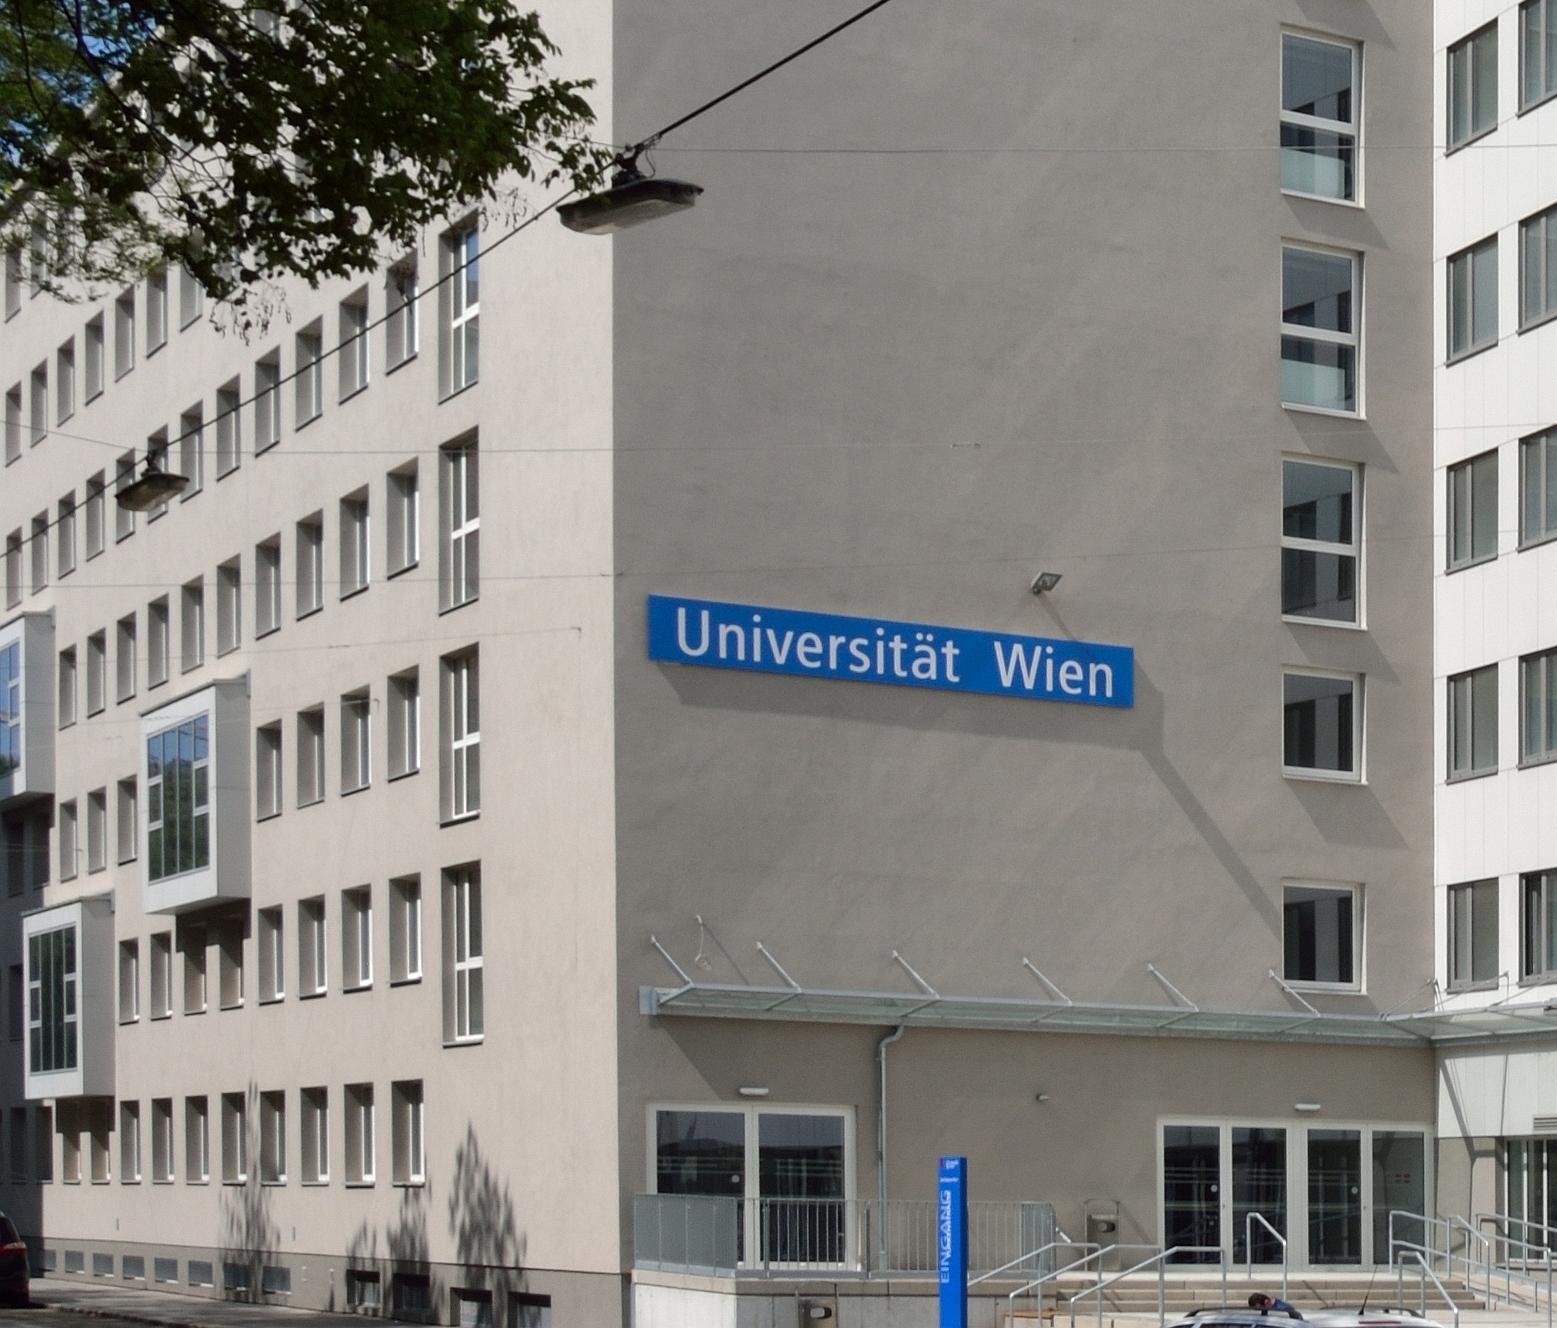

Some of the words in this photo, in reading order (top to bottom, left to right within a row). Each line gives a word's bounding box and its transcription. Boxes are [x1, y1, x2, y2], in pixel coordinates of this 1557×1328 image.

[675, 606, 961, 684] Universität
[993, 640, 1114, 698] Wien
[940, 1190, 951, 1284] EINGANG
